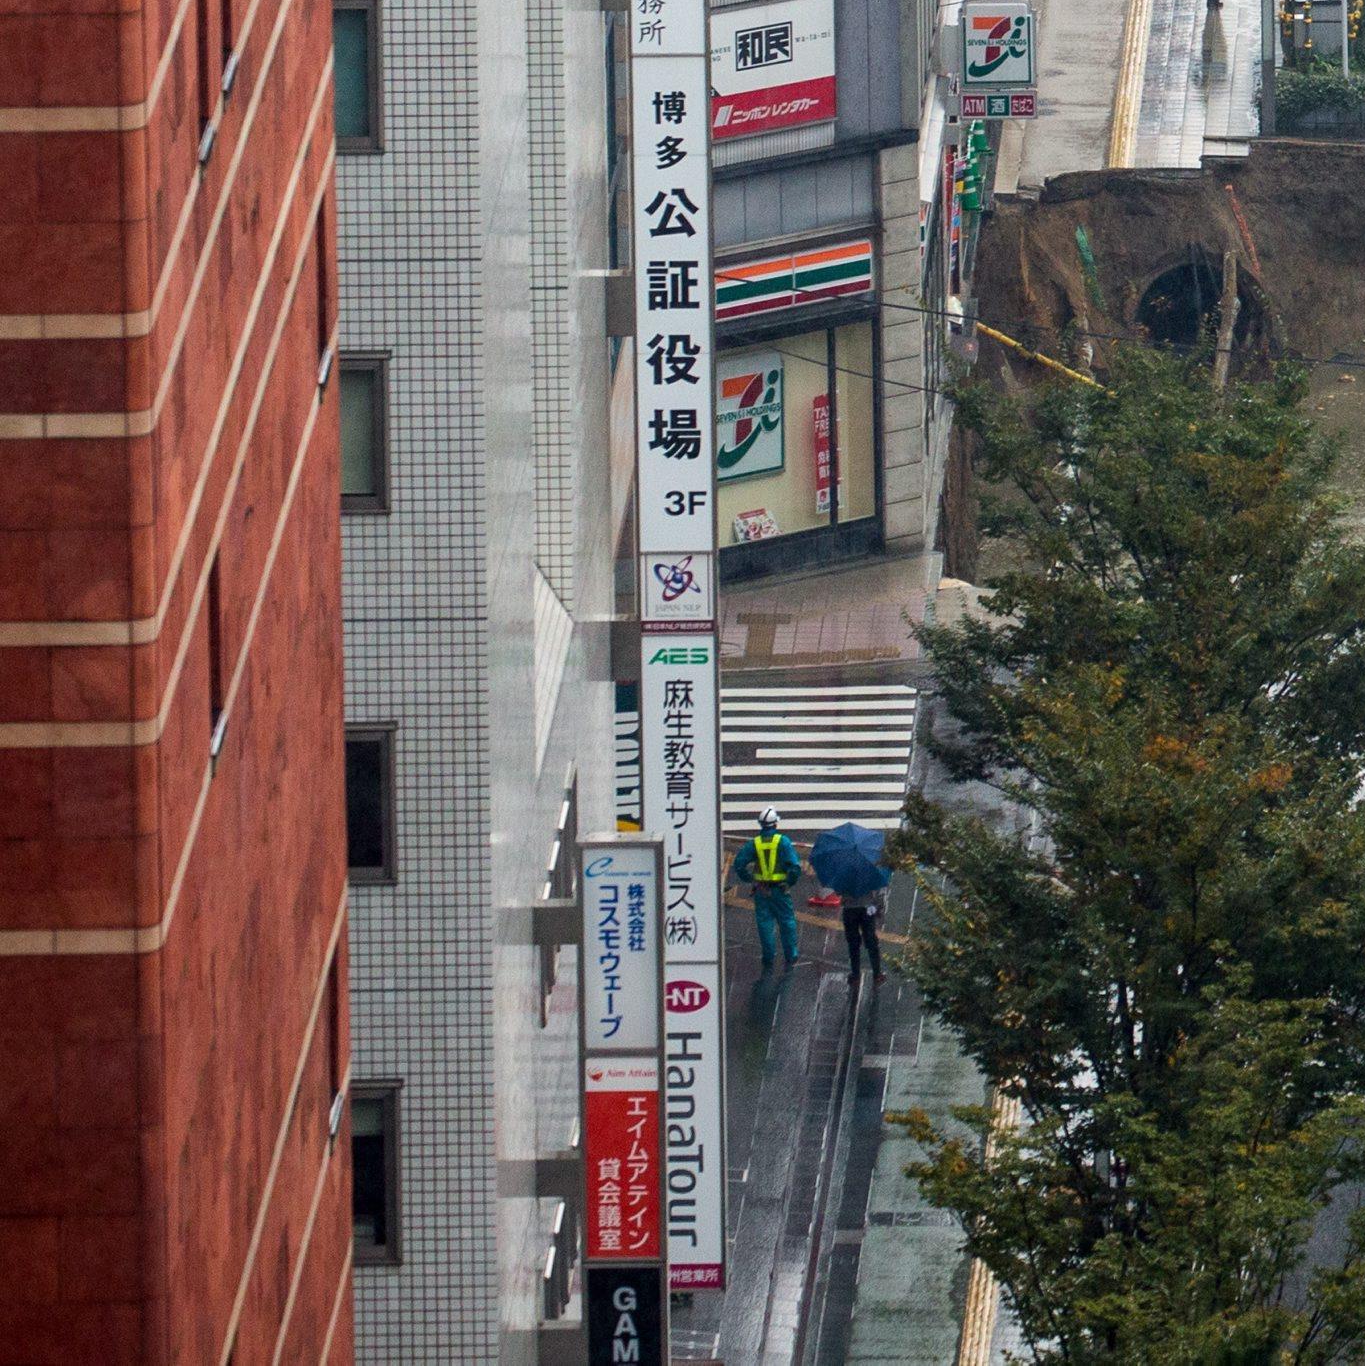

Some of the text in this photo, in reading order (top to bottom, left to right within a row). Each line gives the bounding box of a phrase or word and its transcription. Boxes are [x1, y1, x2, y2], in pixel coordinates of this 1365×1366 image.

[738, 25, 790, 67] 和民
[963, 96, 986, 115] ATM
[990, 96, 1006, 115] 酒
[1012, 98, 1034, 115] たばこ
[644, 90, 707, 517] 博多公証役場 3F
[648, 647, 709, 666] AES
[627, 883, 646, 952] 株式会社
[598, 884, 622, 1039] コスモウェーブ
[667, 1032, 703, 1248] HanaTour
[597, 1158, 622, 1250] 貸会議室
[612, 1286, 640, 1366] GAM
